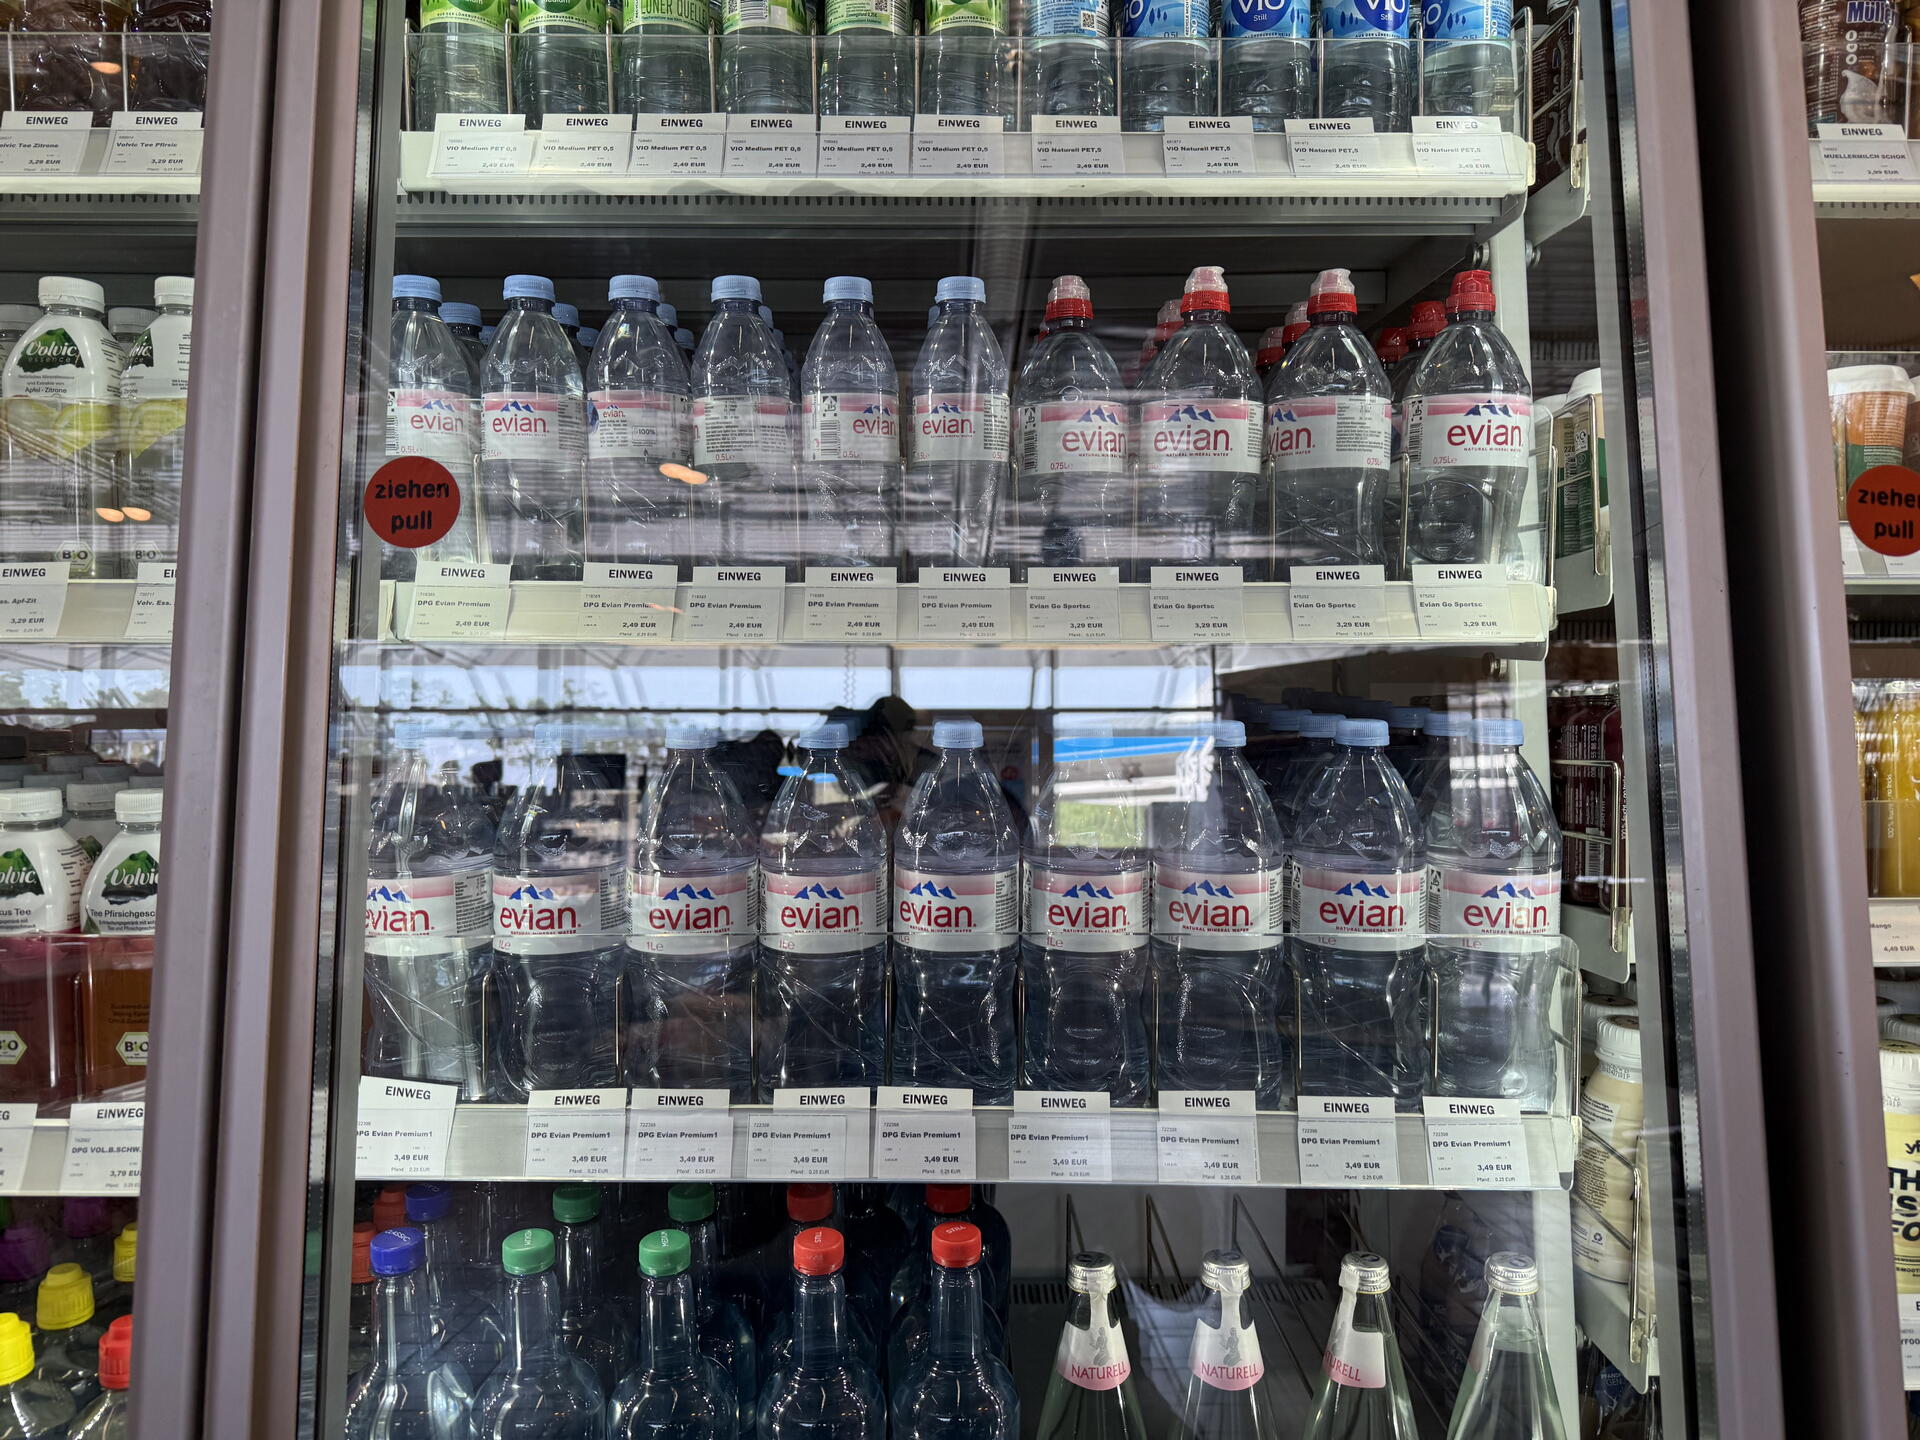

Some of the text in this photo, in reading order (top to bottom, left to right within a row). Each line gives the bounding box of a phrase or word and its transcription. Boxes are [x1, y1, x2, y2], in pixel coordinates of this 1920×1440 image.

[25, 116, 68, 125] EINWEG
[135, 116, 178, 125] EINWEG
[459, 119, 502, 128] EINWEG
[566, 118, 609, 127] EINWEG
[661, 119, 704, 128] EINWEG
[750, 119, 793, 128] EINWEG
[844, 120, 887, 129] EINWEG
[938, 119, 981, 128] EINWEG
[1055, 119, 1098, 129] EINWEG
[1188, 120, 1231, 129] EINWEG
[1308, 122, 1351, 131] EINWEG
[1841, 128, 1883, 136] EINWEG
[26, 341, 78, 357] Volvic
[375, 479, 449, 499] ziehen
[1857, 488, 1920, 509] ziehe
[391, 510, 432, 534] pull
[1874, 520, 1914, 540] pull
[2, 568, 46, 578] EINWEG
[441, 567, 486, 579] EINWEG
[608, 569, 653, 580] EINWEG
[717, 572, 761, 581] EINWEG
[830, 572, 874, 582] EINWEG
[943, 573, 987, 582] EINWEG
[1053, 573, 1097, 582] EINWEG
[1175, 572, 1219, 581] EINWEG
[1315, 571, 1360, 581] EINWEG
[1437, 570, 1482, 580] EINWEG
[14, 909, 32, 917] Tee
[90, 909, 103, 919] Tee
[385, 1085, 431, 1100] EINWEG
[554, 1094, 601, 1106] EINWEG
[657, 1095, 704, 1106] EINWEG
[799, 1094, 845, 1105] EINWEG
[902, 1094, 948, 1105] EINWEG
[1041, 1097, 1087, 1109] EINWEG
[1184, 1097, 1230, 1108] EINWEG
[96, 1107, 144, 1119] EINWEG
[1323, 1103, 1370, 1113] EINWEG
[1449, 1103, 1495, 1115] EINWEG
[572, 1155, 607, 1163] 3,49 EUR
[679, 1155, 715, 1163] 3,49 EUR
[1071, 1362, 1127, 1380] NATURELL
[1201, 1362, 1259, 1379] NATURELL
